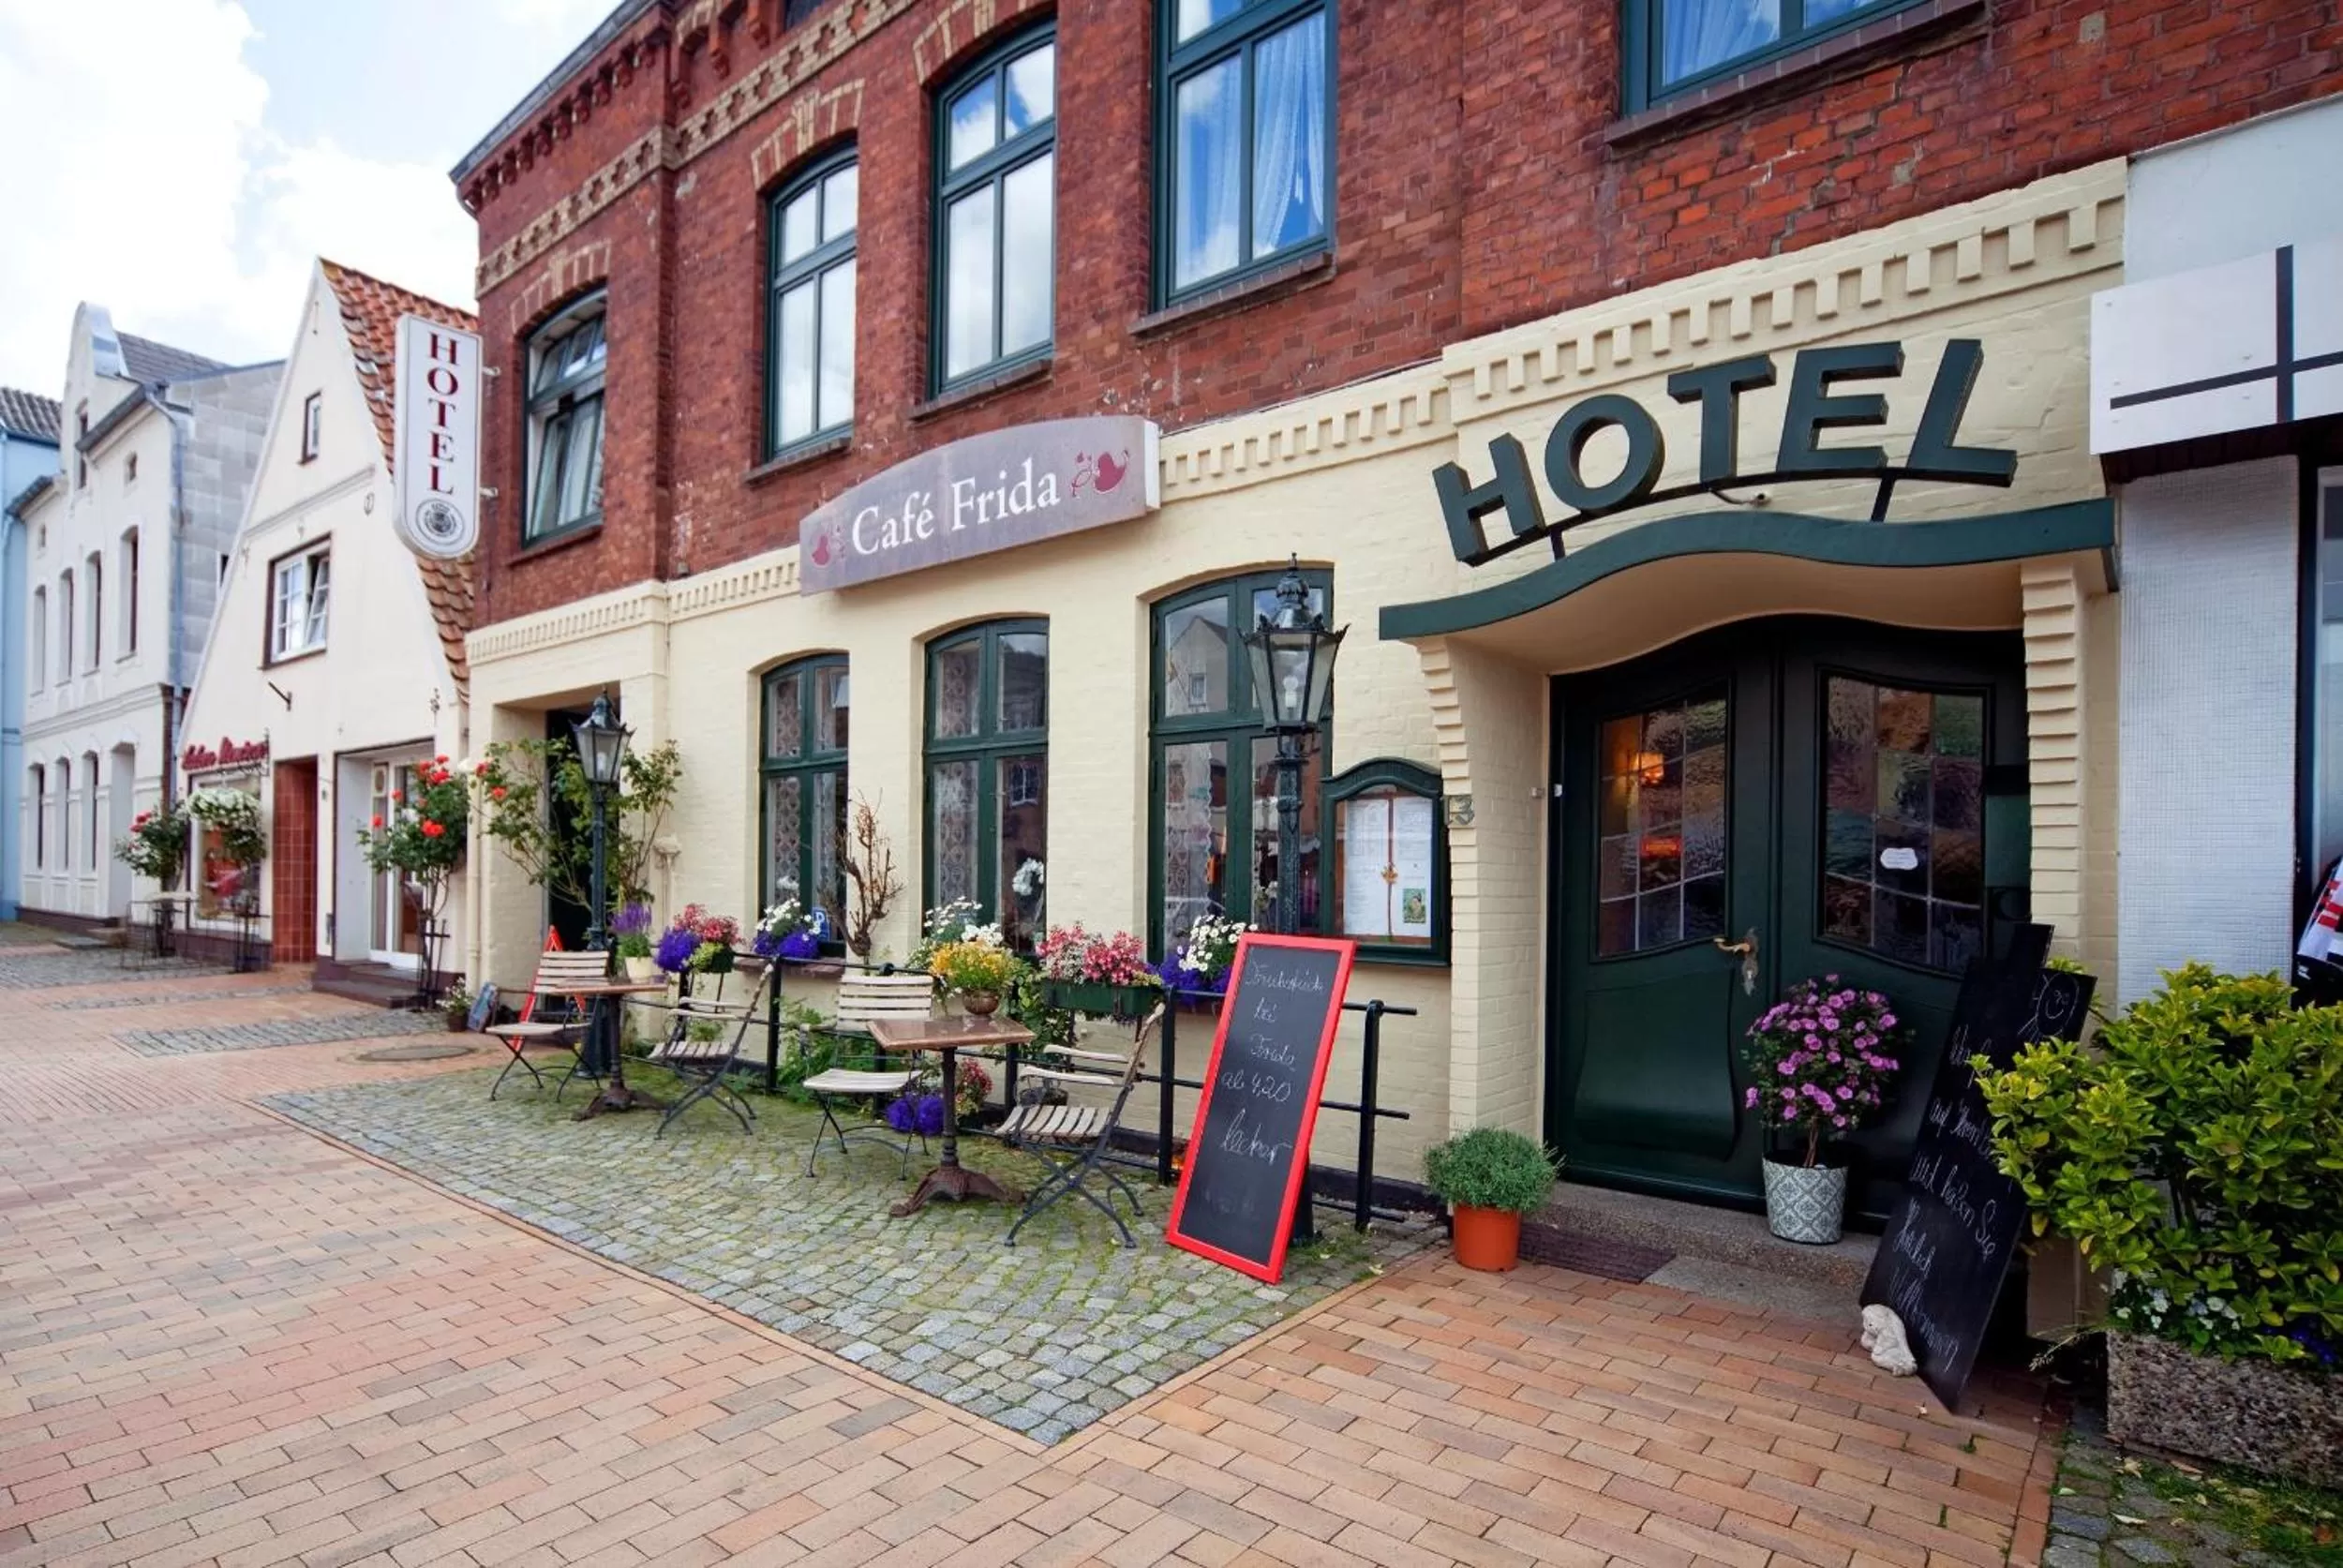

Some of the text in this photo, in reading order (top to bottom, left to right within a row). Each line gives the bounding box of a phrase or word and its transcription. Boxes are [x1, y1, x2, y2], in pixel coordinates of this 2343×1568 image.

[426, 332, 460, 496] HOTEL
[1432, 338, 2018, 567] HOTEL
[852, 457, 1061, 555] Café Frida
[1251, 1072, 1291, 1102] 4,20
